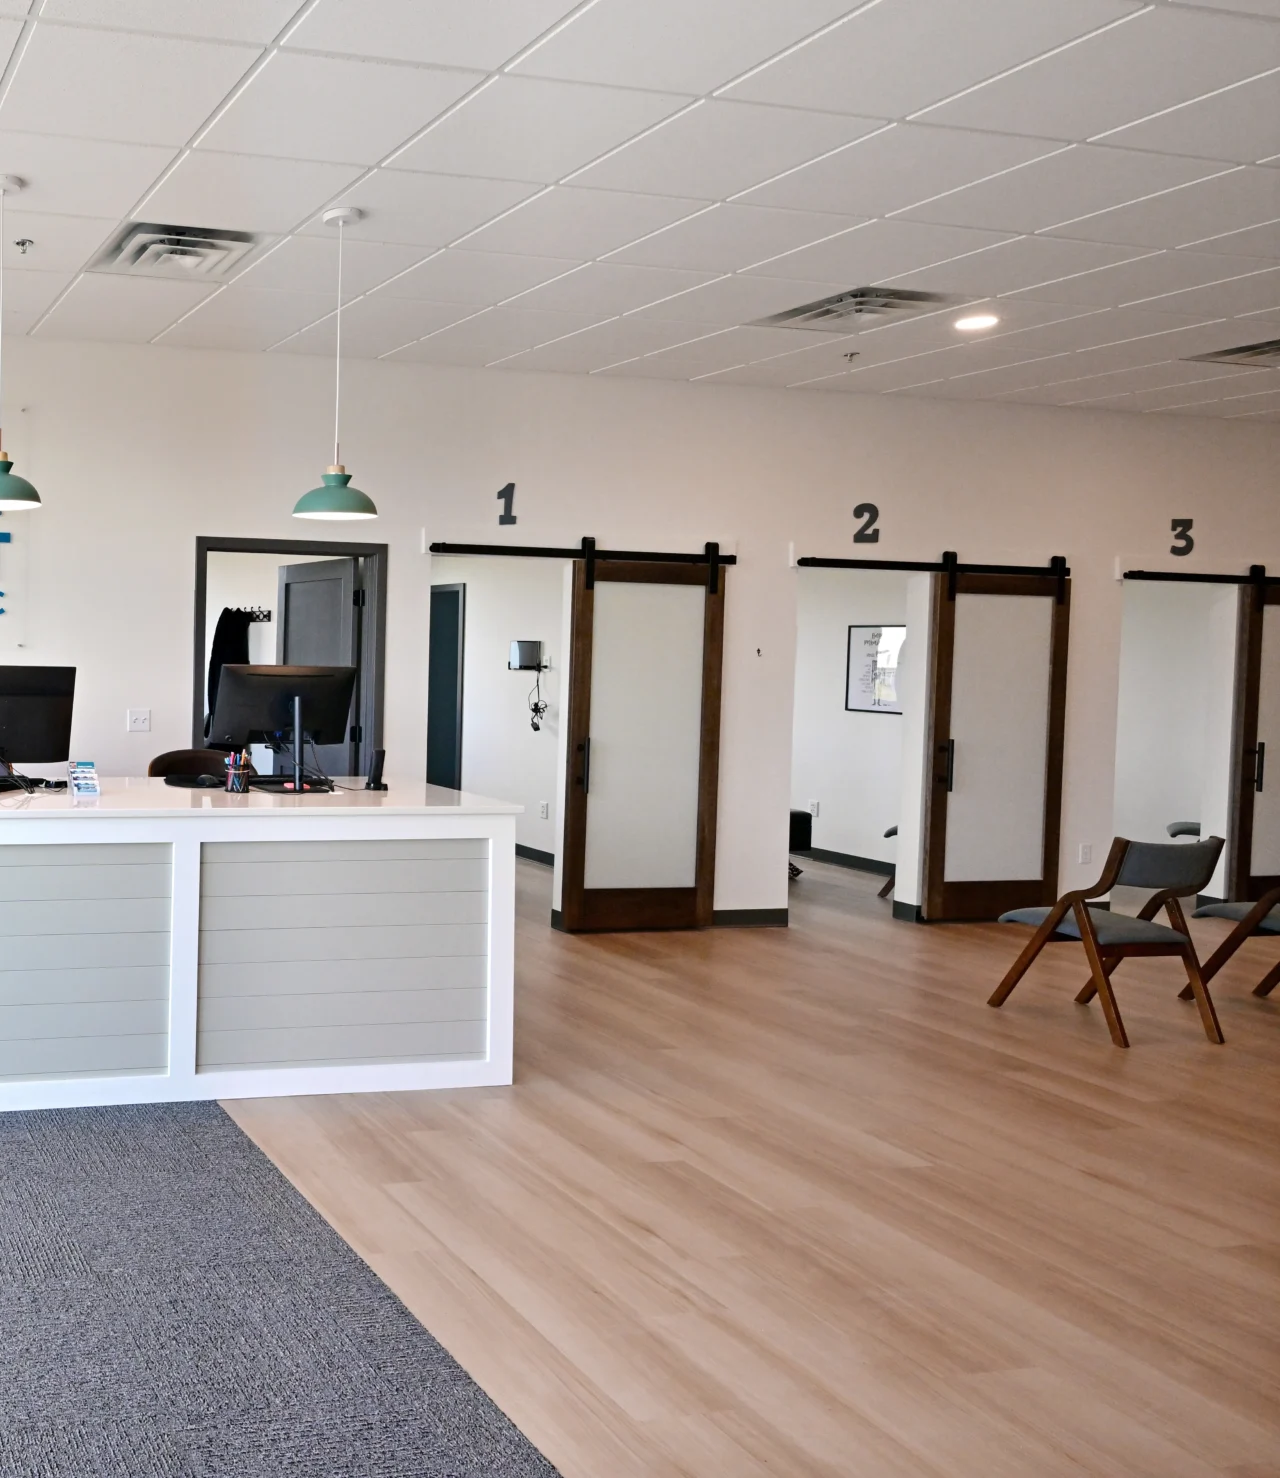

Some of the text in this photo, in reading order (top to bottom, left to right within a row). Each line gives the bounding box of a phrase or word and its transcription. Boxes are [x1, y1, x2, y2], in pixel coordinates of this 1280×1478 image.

[496, 482, 517, 526] 1
[852, 502, 880, 544] 2
[1169, 518, 1195, 557] 3
